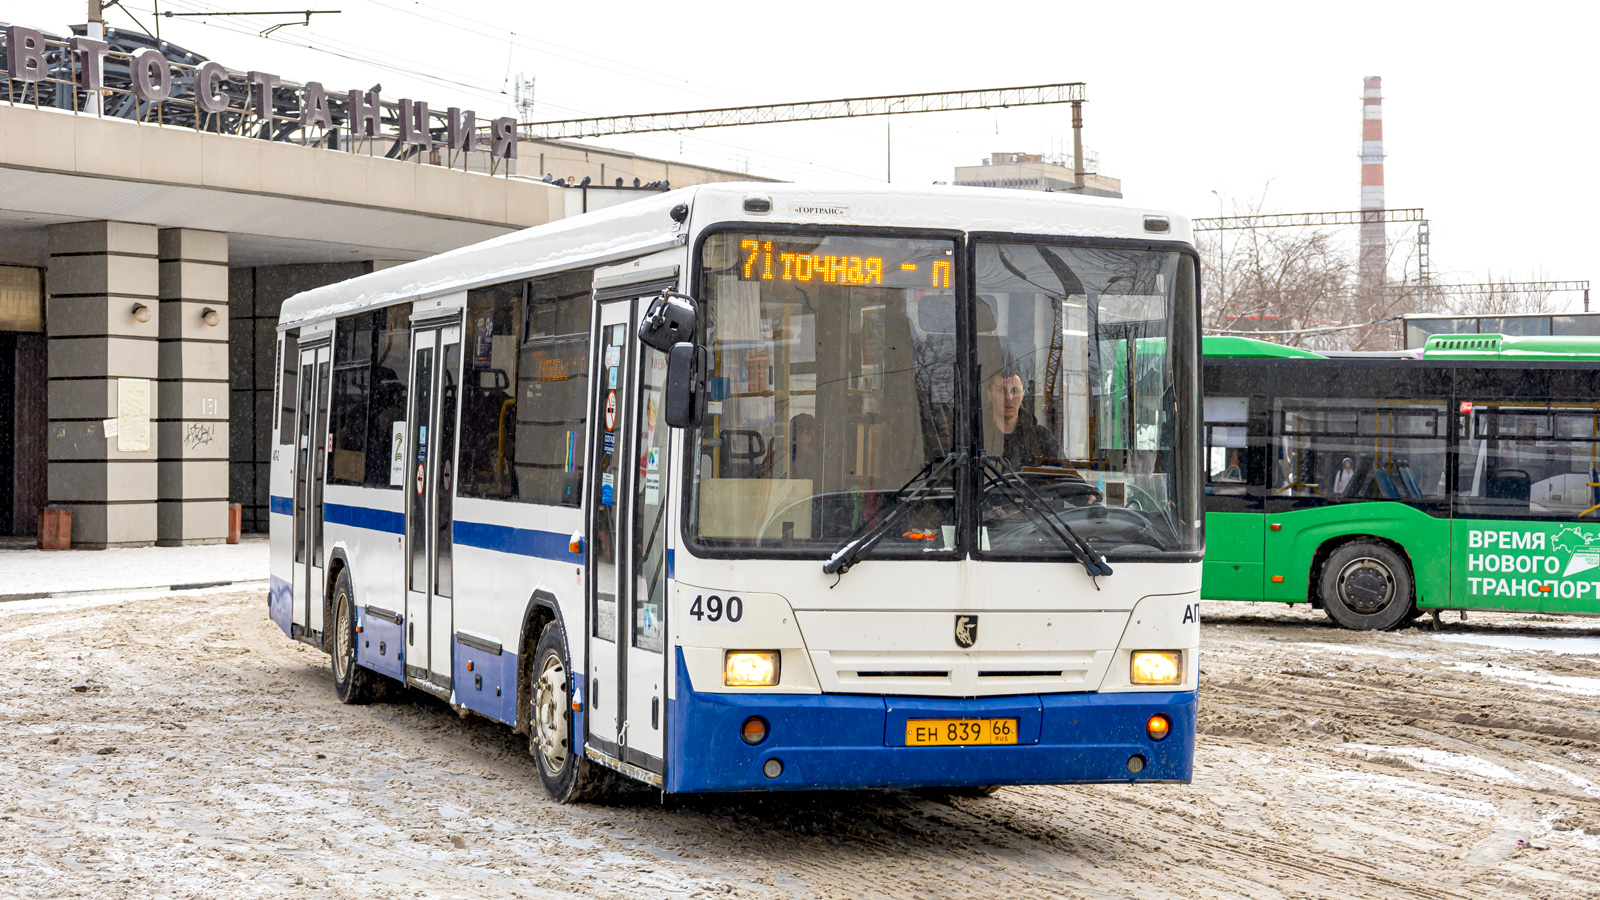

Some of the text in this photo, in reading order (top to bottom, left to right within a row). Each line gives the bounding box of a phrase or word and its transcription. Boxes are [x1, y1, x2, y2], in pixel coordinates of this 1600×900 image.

[6, 26, 517, 159] ВТОСТАНЦИЯ
[741, 240, 773, 279] 71
[781, 253, 882, 284] точная
[1469, 530, 1545, 550] ВРЕМЯ
[1468, 553, 1560, 574] НОВОГО
[689, 594, 743, 623] 490
[916, 721, 1010, 742] ЕН 839 66
